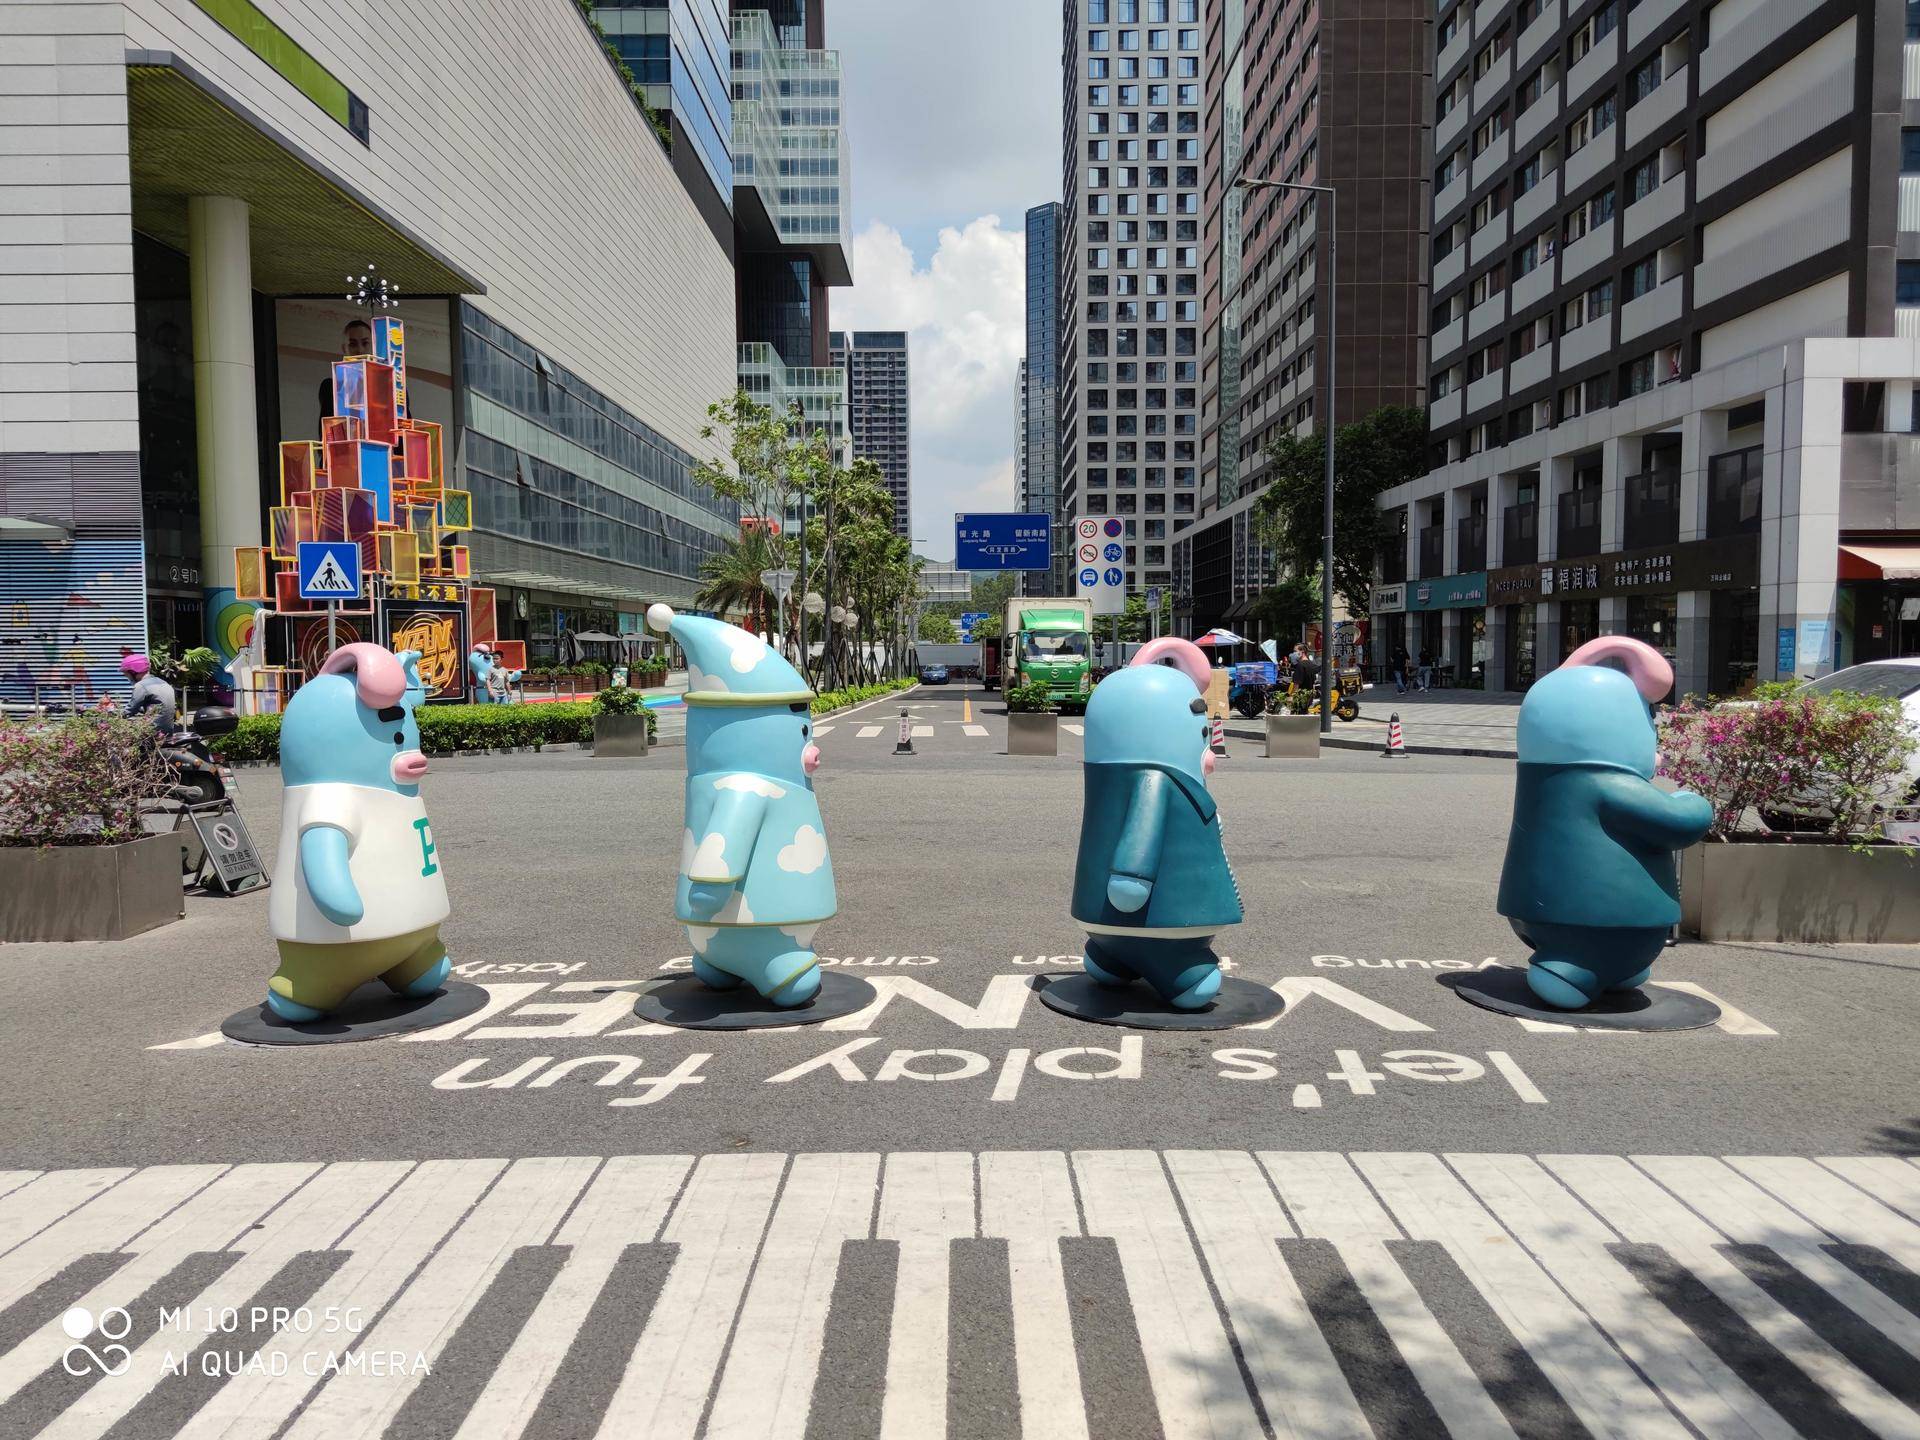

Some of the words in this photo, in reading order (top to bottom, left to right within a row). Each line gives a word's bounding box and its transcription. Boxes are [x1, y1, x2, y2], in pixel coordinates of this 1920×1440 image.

[1083, 524, 1095, 534] 20
[1558, 564, 1598, 591] 福润诚
[220, 849, 252, 864] 请勿泊车
[1311, 955, 1514, 970] young
[428, 1053, 711, 1107] fun
[763, 1036, 1144, 1102] play
[1209, 1048, 1551, 1108] let's
